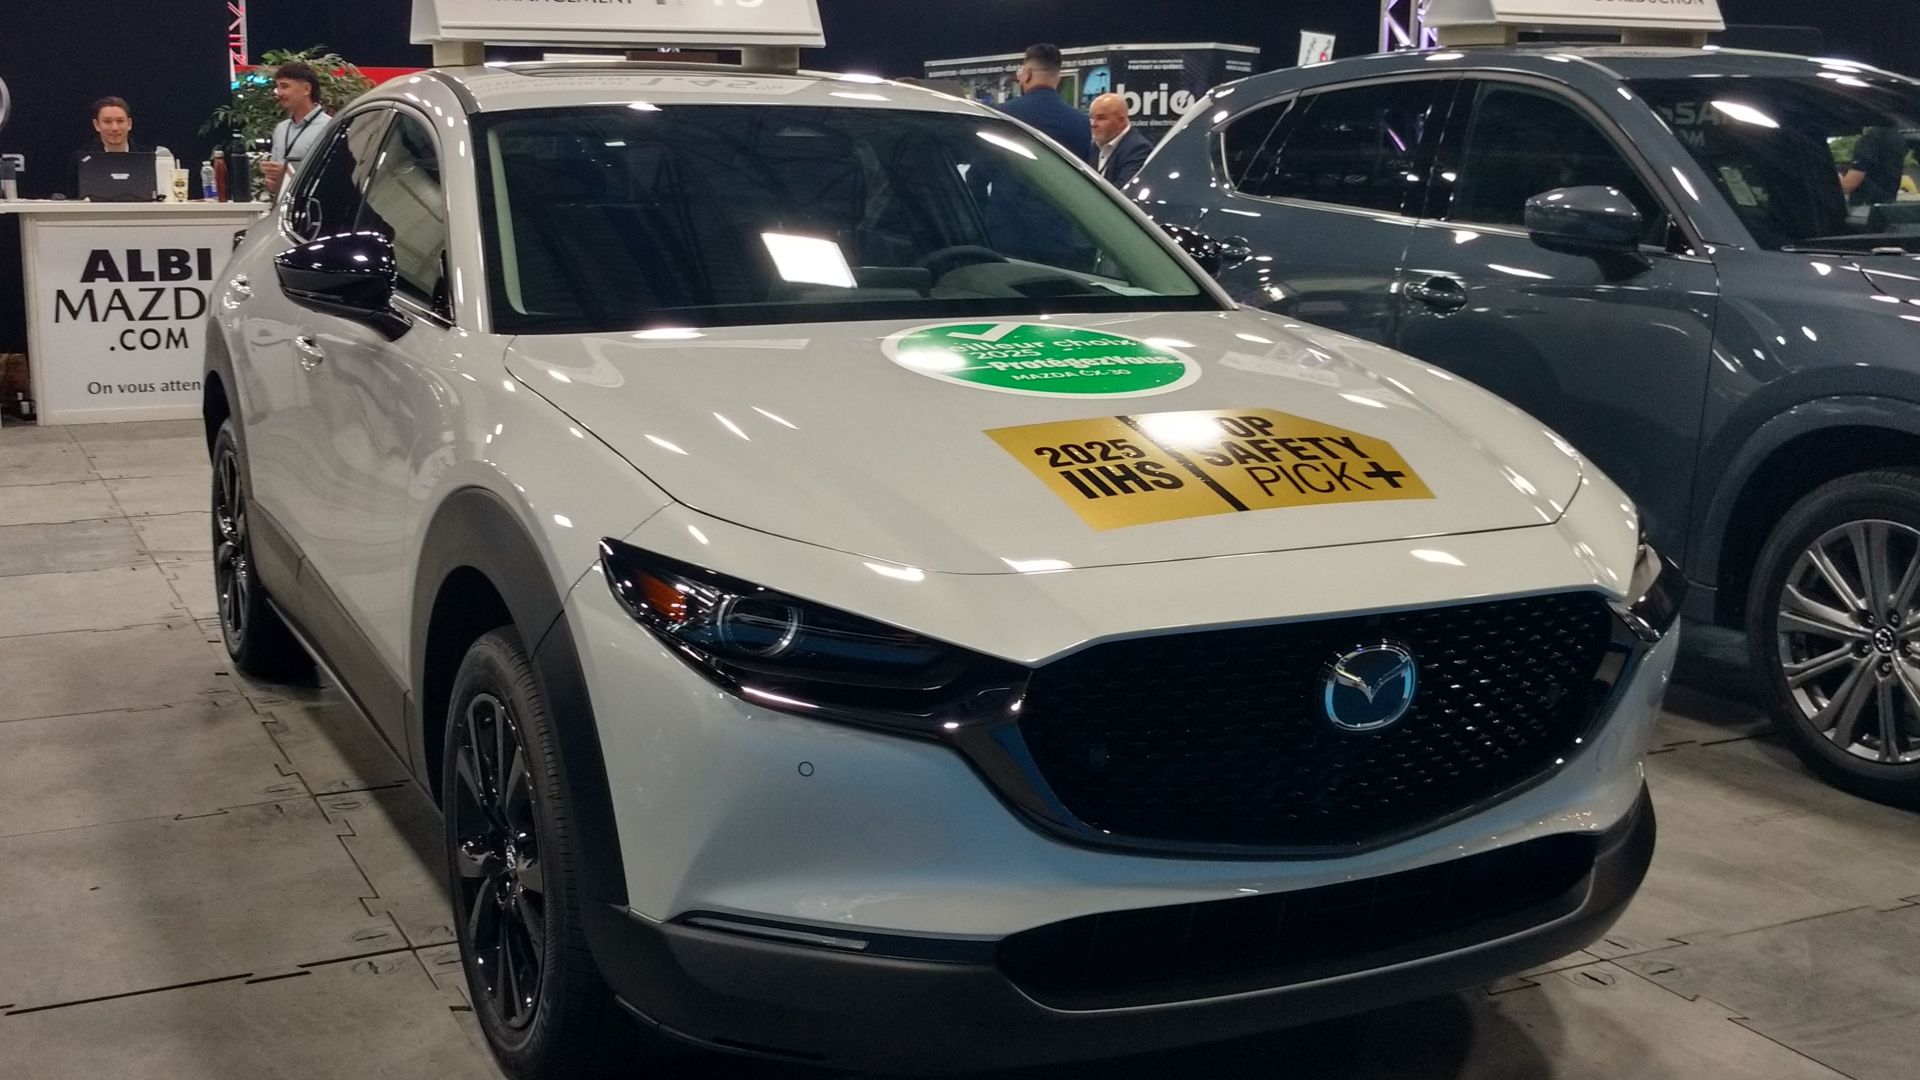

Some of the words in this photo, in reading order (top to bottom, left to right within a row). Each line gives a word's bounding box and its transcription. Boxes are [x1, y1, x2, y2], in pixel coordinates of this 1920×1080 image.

[80, 248, 213, 283] ALBI
[54, 286, 207, 323] MAZD
[109, 327, 189, 351] .COM
[945, 340, 1046, 353] eilleur
[968, 348, 1042, 360] 2025
[87, 381, 114, 395] On
[117, 382, 156, 393] vous
[160, 380, 203, 392] atten
[1011, 370, 1080, 381] MAZDA
[1079, 368, 1131, 377] CX-30
[1034, 438, 1146, 468] 2025
[1211, 415, 1276, 438] OP
[1199, 436, 1372, 467] SAFETY
[1058, 460, 1184, 499] IIHS
